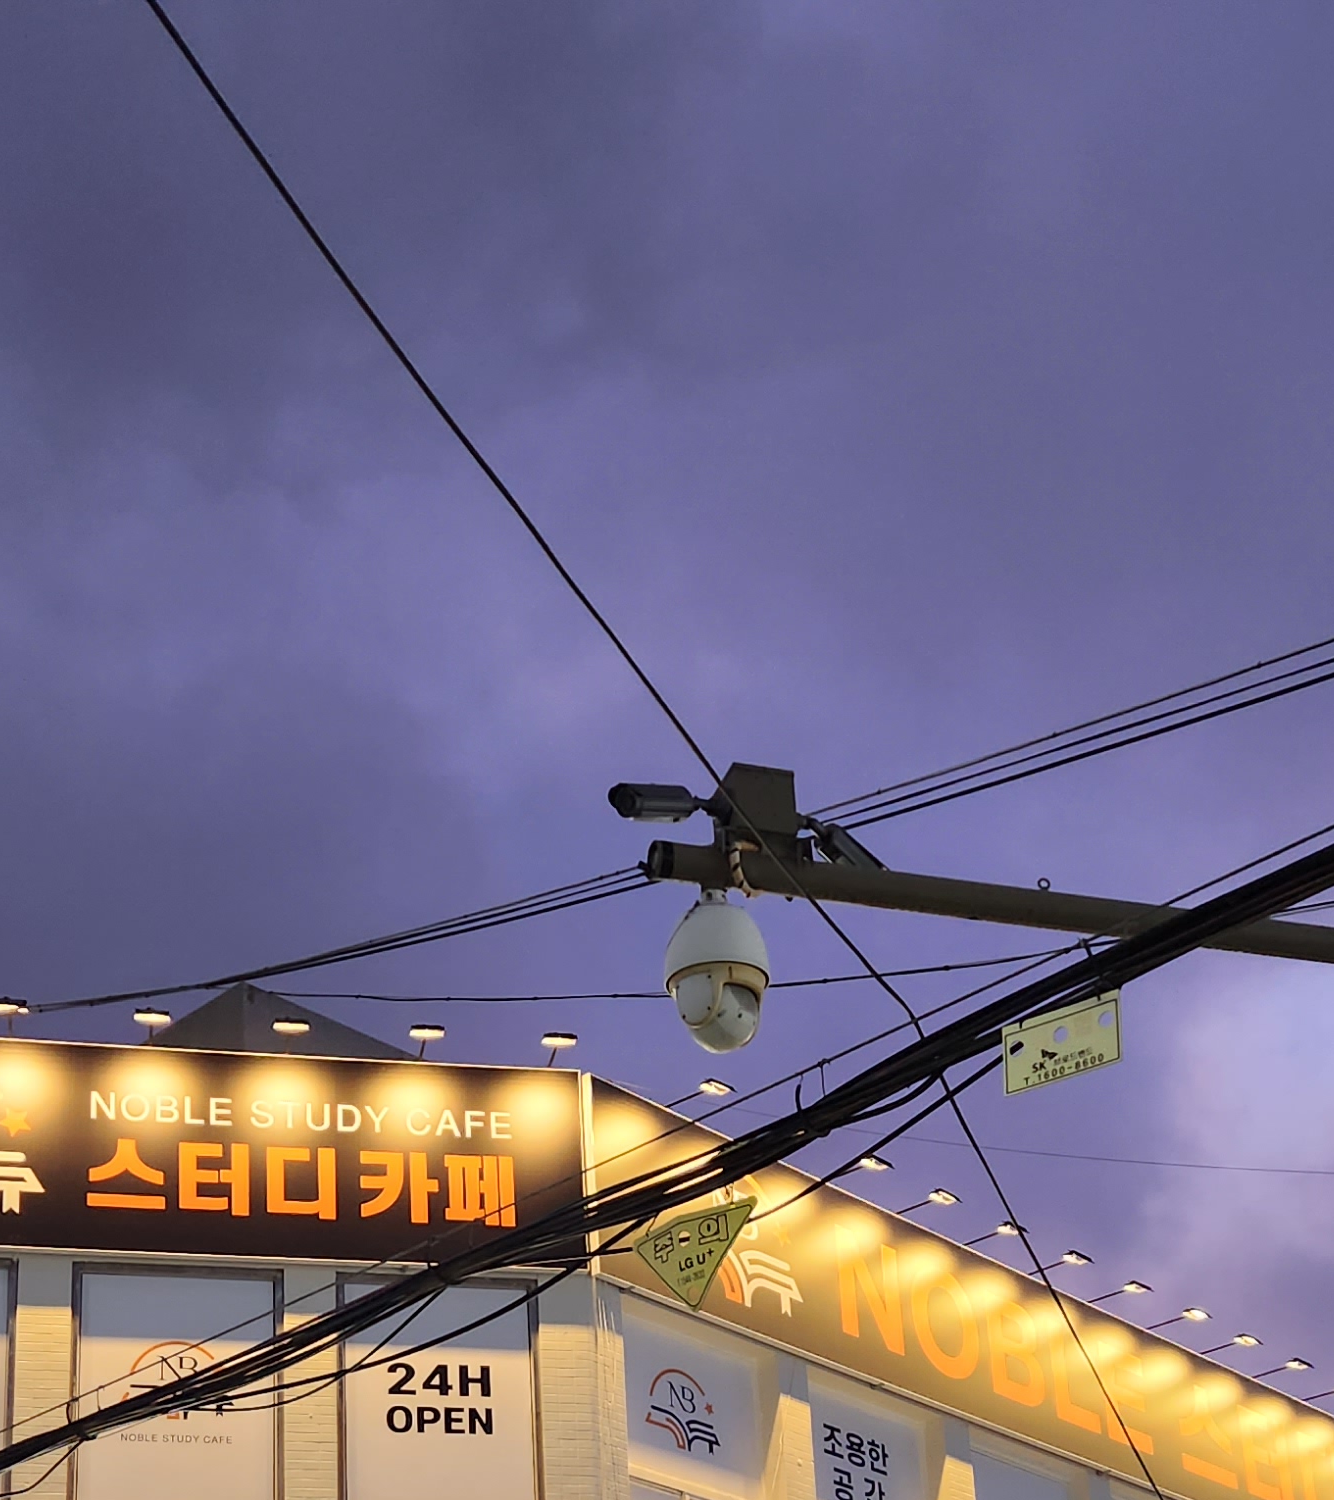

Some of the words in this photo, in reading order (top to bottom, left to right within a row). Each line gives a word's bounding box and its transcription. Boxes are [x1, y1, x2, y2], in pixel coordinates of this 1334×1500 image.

[1032, 1060, 1046, 1073] SK
[90, 1090, 233, 1128] NOBLE
[250, 1100, 390, 1134] STUDY
[406, 1107, 512, 1139] CAFE
[86, 1138, 336, 1220] 스터디
[358, 1151, 517, 1227] 카페
[654, 1215, 729, 1264] 주의
[678, 1257, 695, 1273] LG
[834, 1223, 1154, 1454] NOBLE
[388, 1362, 492, 1396] 24H
[120, 1432, 159, 1443] NOBLE
[163, 1434, 199, 1445] STUDY
[203, 1434, 233, 1445] CAFE
[387, 1406, 494, 1436] OPEN
[822, 1422, 889, 1476] 조용한
